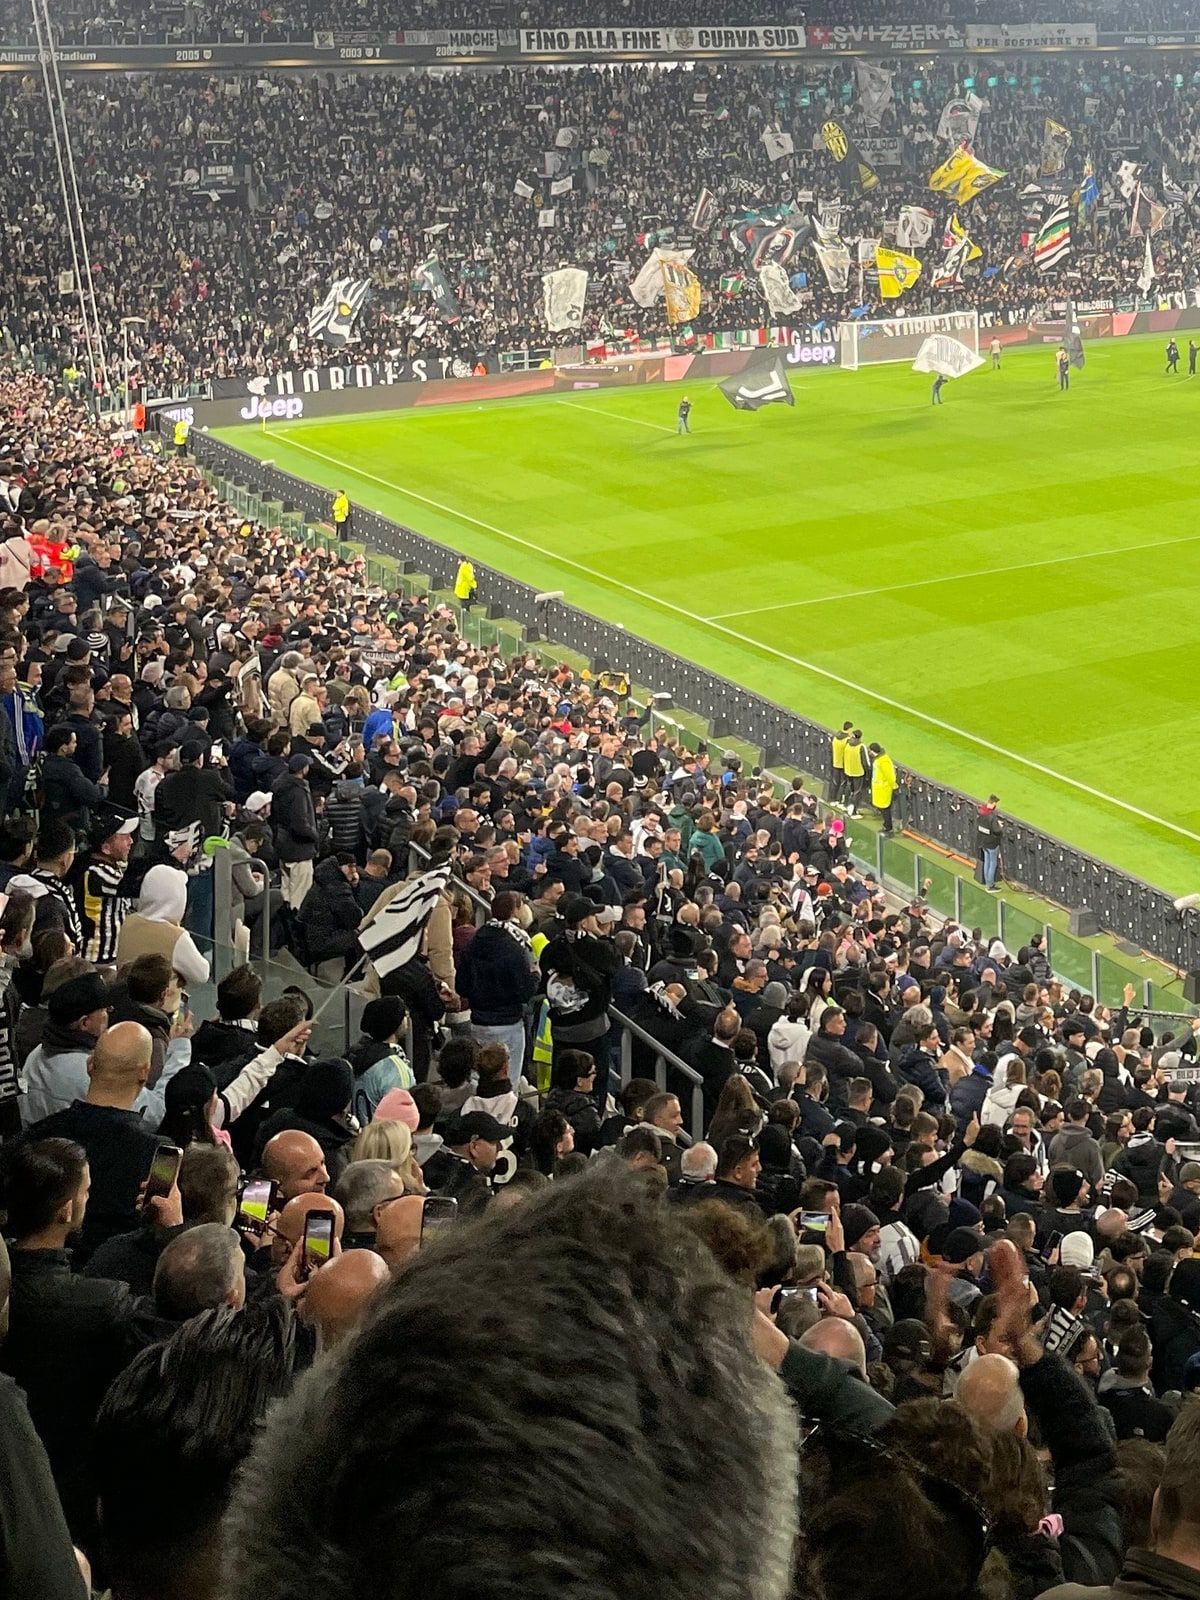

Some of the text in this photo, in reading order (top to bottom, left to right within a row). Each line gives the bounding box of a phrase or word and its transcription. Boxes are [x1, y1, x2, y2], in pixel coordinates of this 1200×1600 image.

[450, 32, 495, 47] MARCHE
[525, 30, 570, 50] FINO
[574, 30, 618, 49] ALLA
[621, 30, 662, 49] FINE
[698, 28, 799, 48] CURVA SUD
[833, 24, 959, 42] SVIZZERA
[787, 345, 835, 363] Jeep
[241, 395, 303, 420] Jeep
